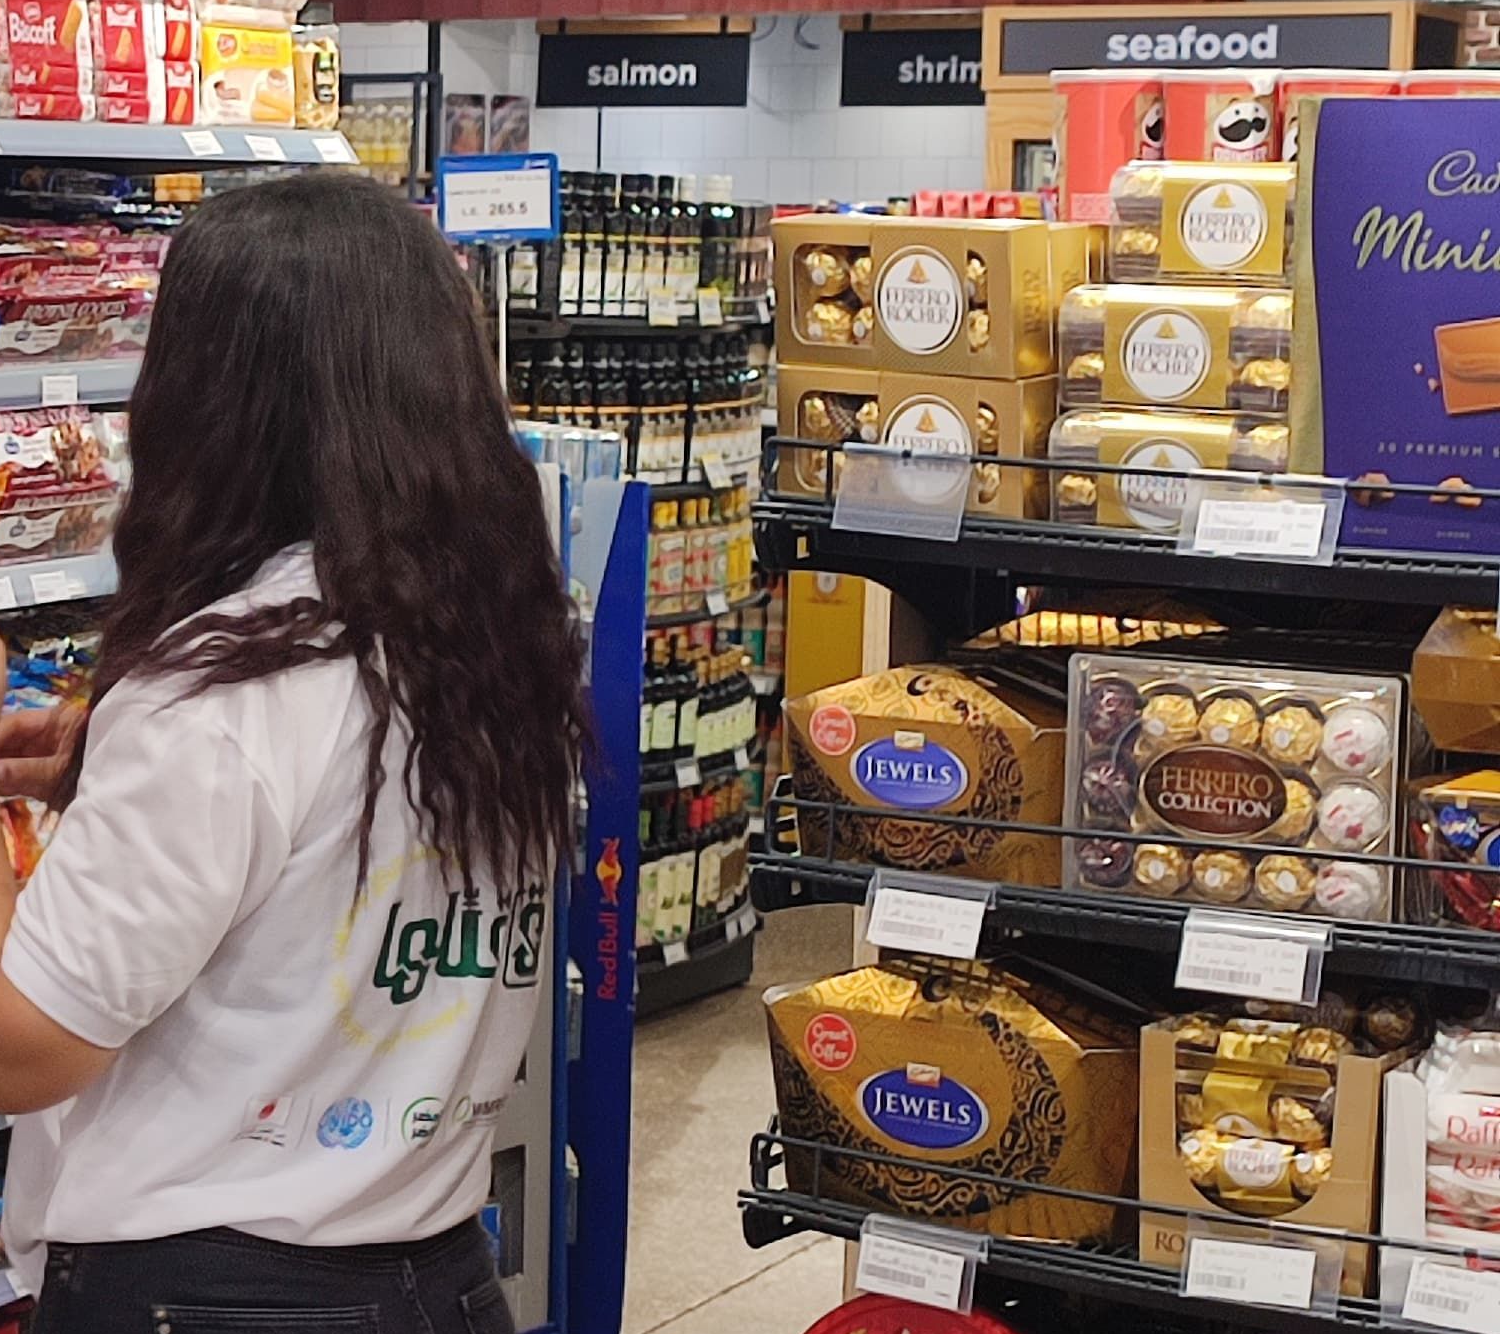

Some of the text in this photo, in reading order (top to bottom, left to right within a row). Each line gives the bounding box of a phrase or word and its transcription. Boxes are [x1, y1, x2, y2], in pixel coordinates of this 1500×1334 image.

[9, 12, 57, 45] Biscoff
[1106, 25, 1278, 61] seafood
[587, 58, 697, 88] salmon
[489, 202, 528, 216] 265.5
[1188, 214, 1256, 229] FERRERO
[1189, 229, 1253, 245] ROCHER
[886, 287, 950, 305] FERRERO
[886, 307, 951, 325] ROCHER
[1132, 344, 1199, 360] FERRERO
[1132, 359, 1197, 376] ROCHER
[1405, 443, 1483, 456] PREMIUM
[1127, 476, 1188, 491] FERRER
[861, 754, 953, 785] JEWELS
[1161, 767, 1274, 799] FERRERO
[1156, 791, 1273, 819] COLLECTION
[598, 912, 617, 1001] Red Bull
[811, 1023, 850, 1044] Great
[811, 1041, 849, 1063] Offer
[872, 1087, 973, 1125] JEWELS
